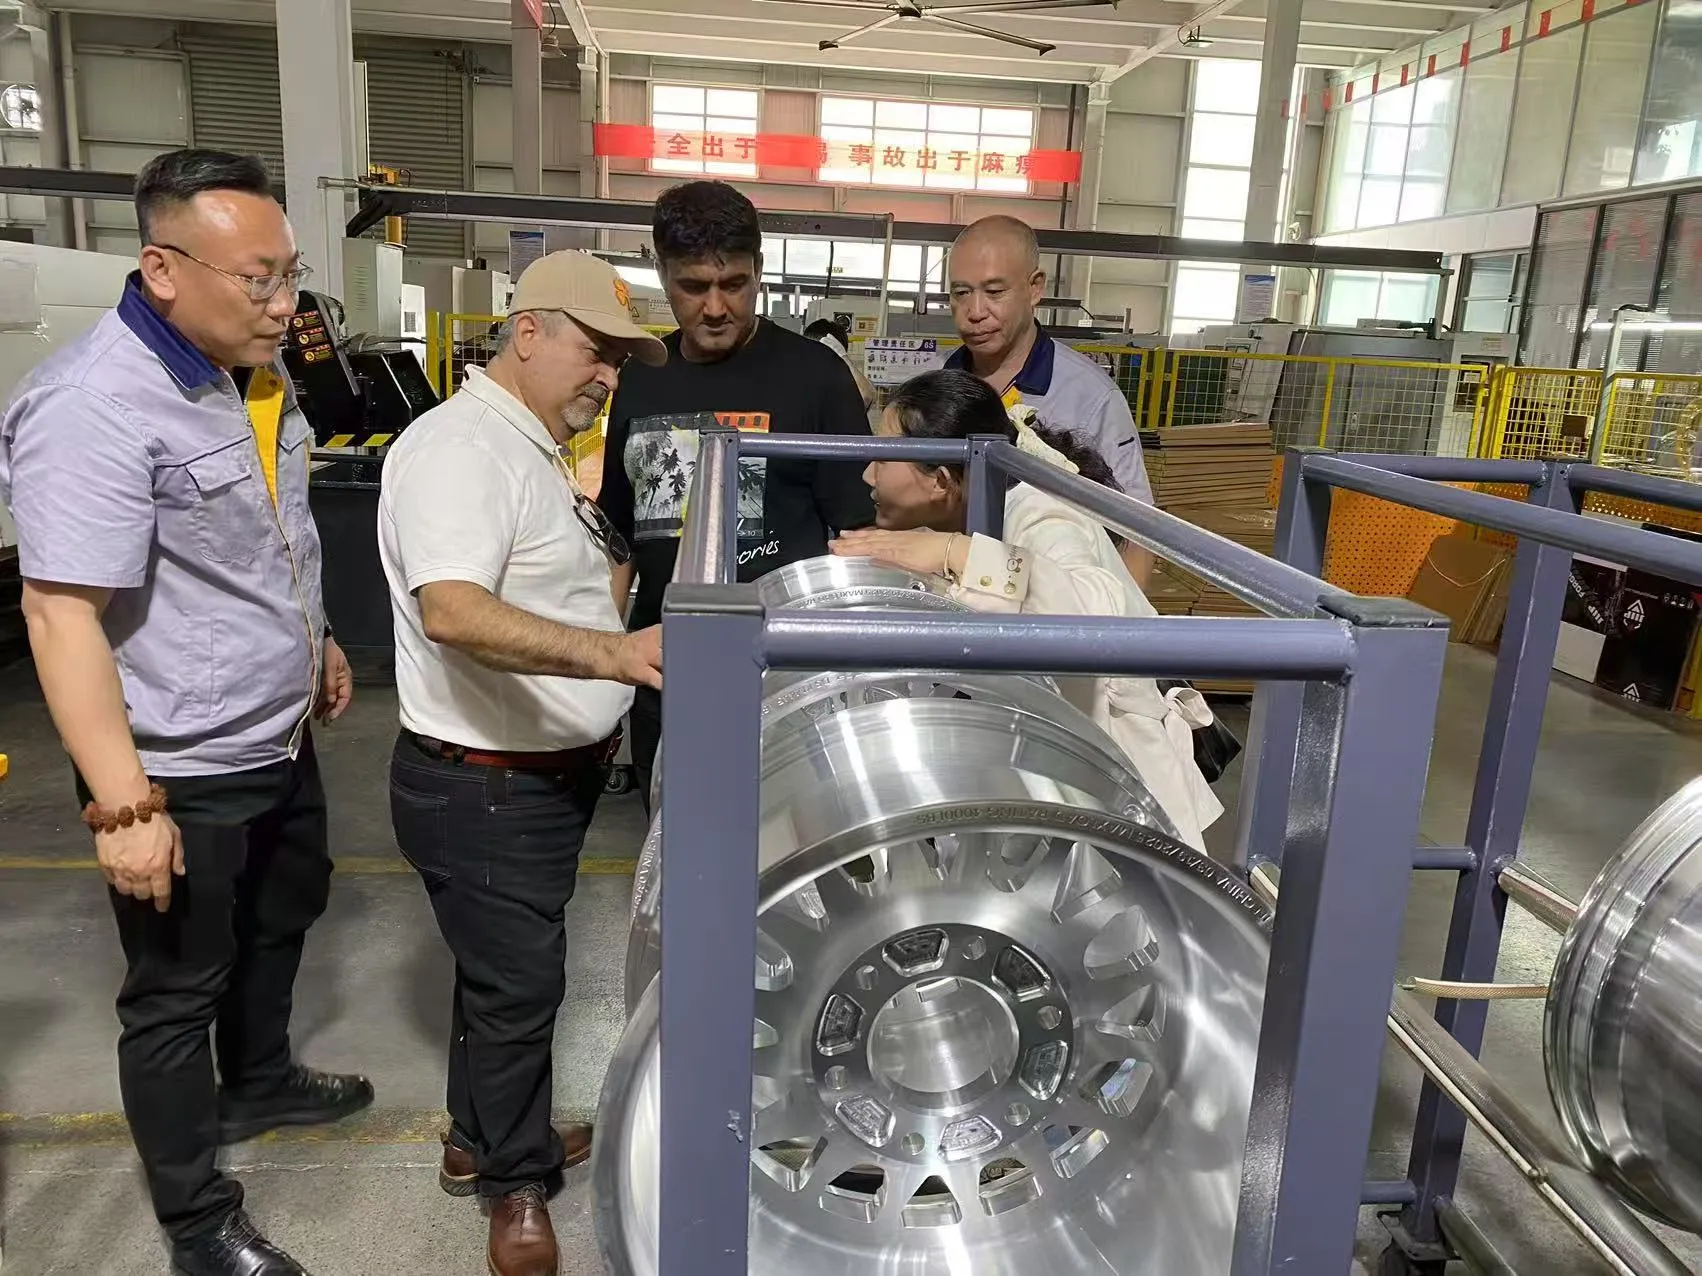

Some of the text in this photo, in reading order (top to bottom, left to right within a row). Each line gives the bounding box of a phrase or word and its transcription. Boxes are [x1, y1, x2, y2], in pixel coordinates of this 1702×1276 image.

[873, 340, 935, 349] 管理责任区 6S
[987, 806, 1049, 819] RATING
